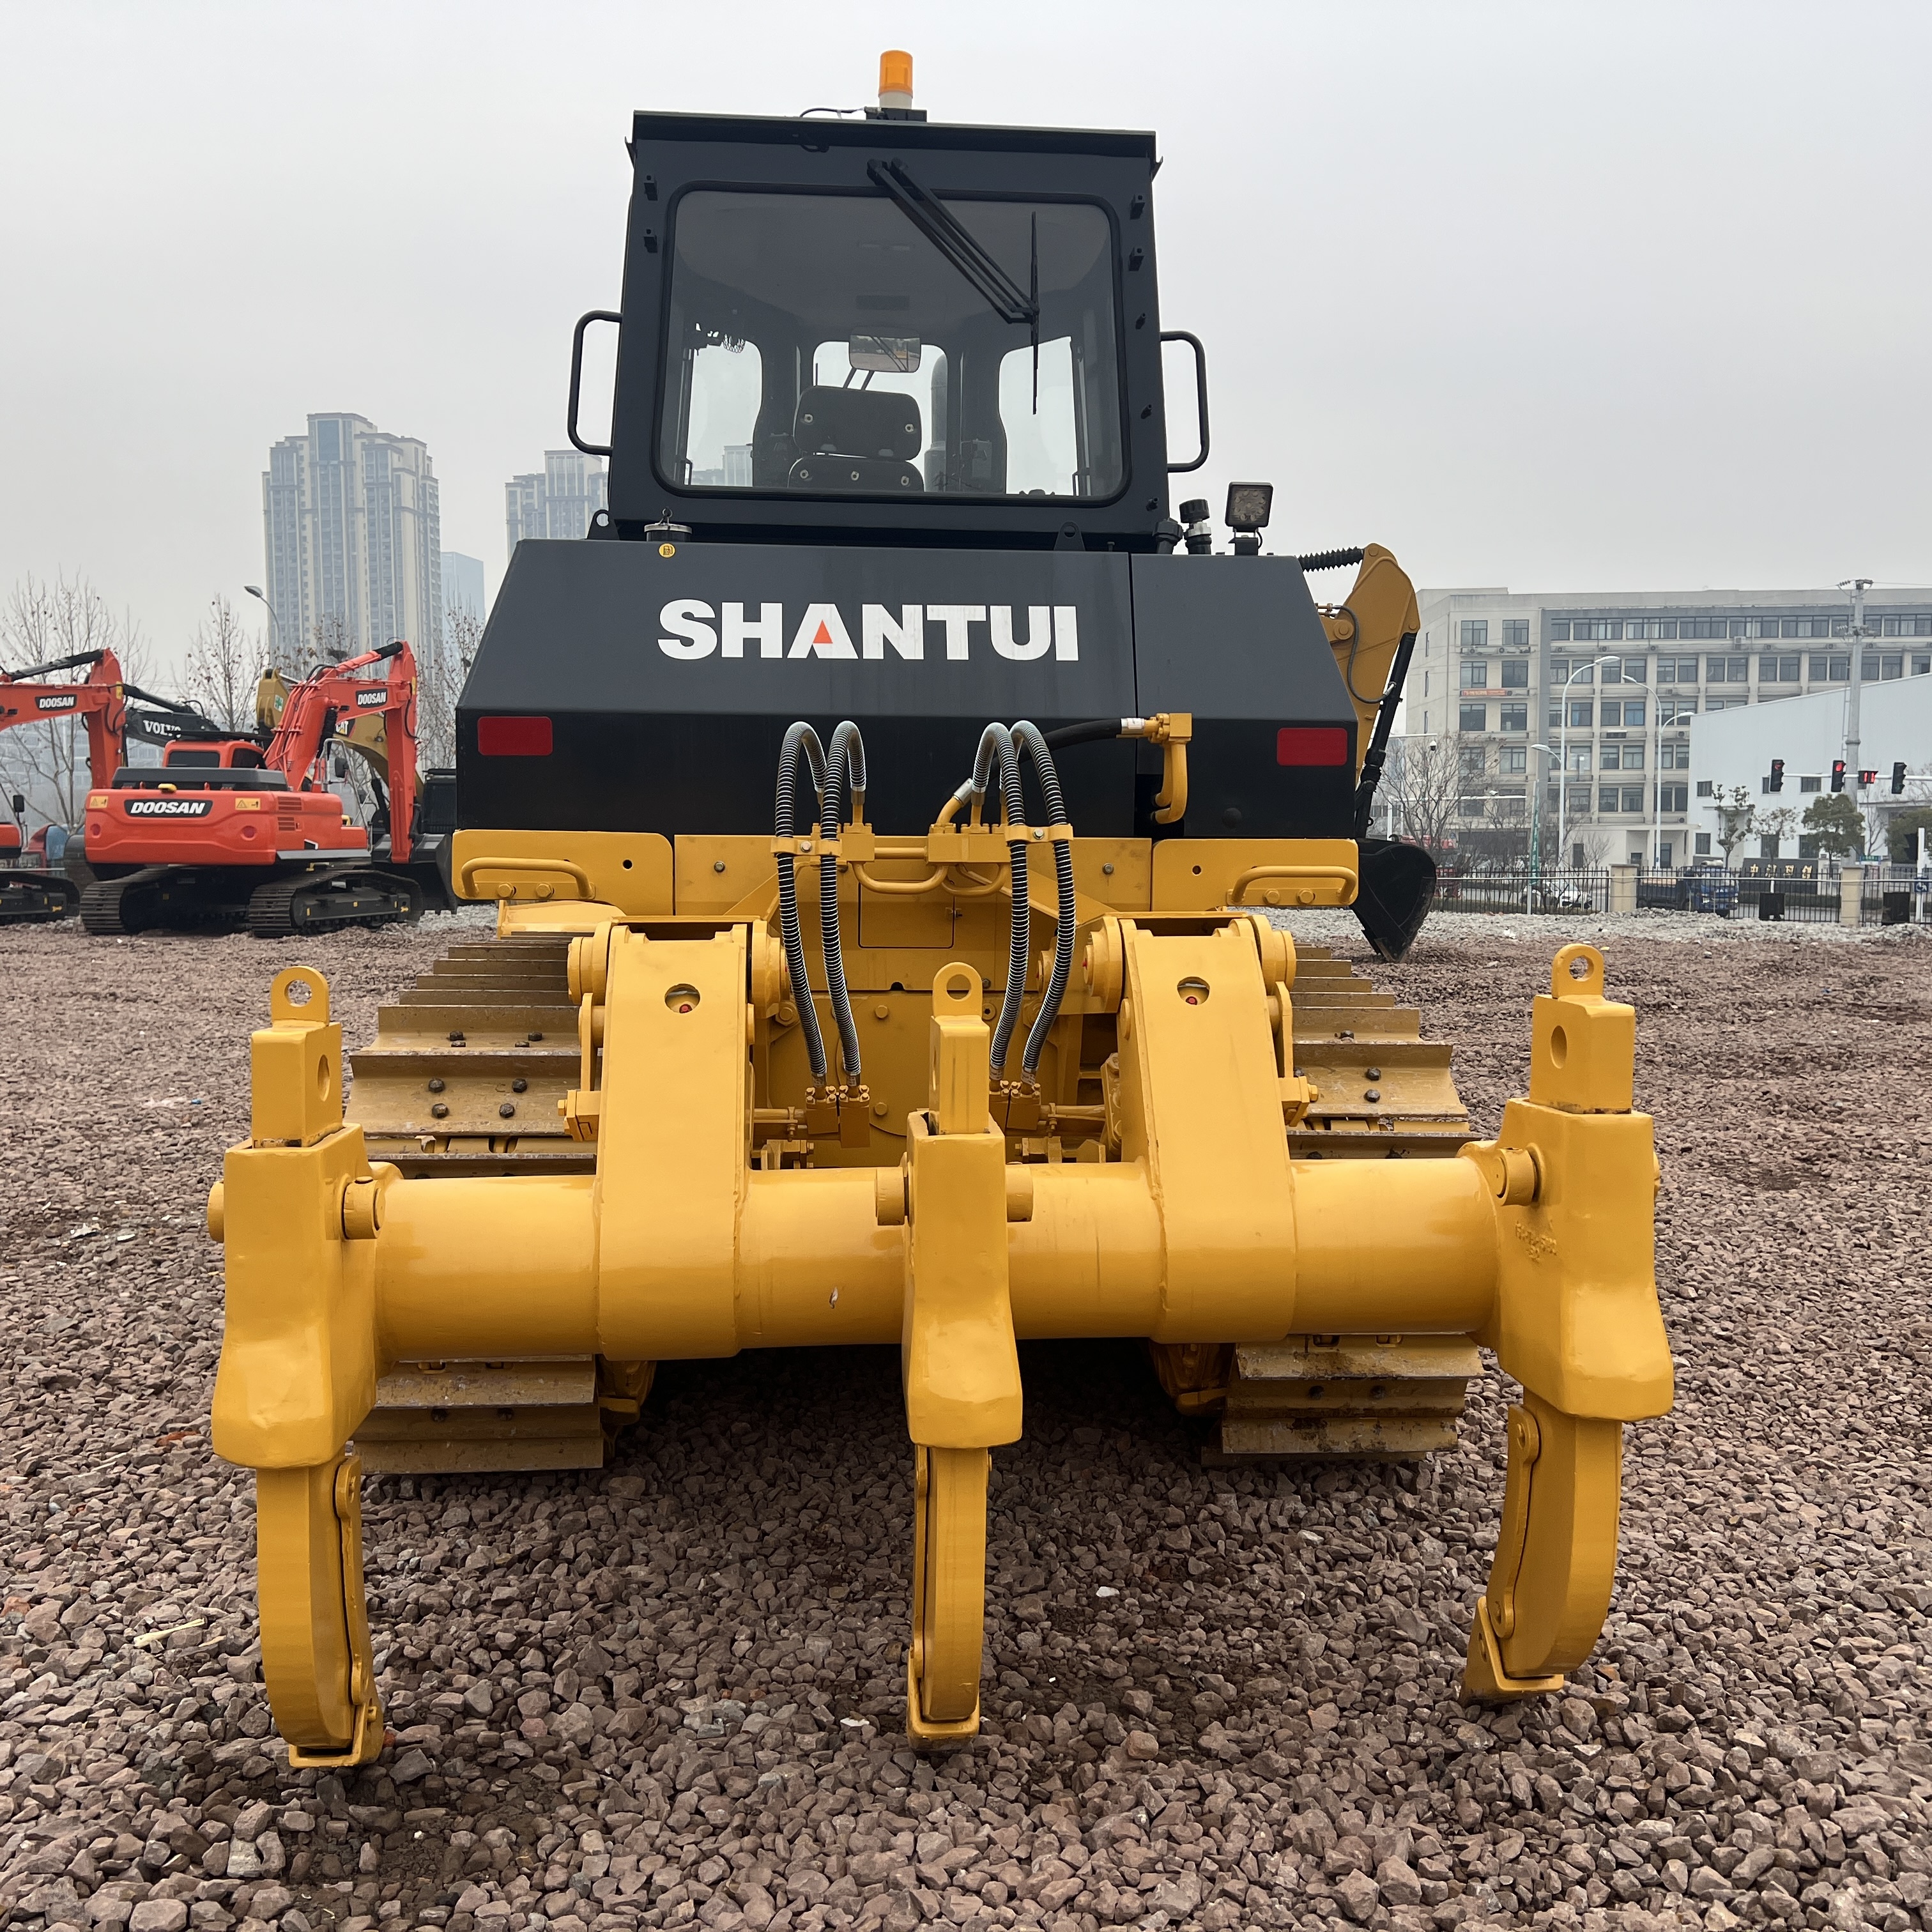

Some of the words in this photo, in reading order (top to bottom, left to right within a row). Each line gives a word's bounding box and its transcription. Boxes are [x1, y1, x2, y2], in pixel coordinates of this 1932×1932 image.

[657, 599, 1078, 661] SHANTUI
[39, 696, 75, 709] DOOSAN
[358, 691, 387, 705] DOOSAN
[130, 801, 206, 815] DOOSAN
